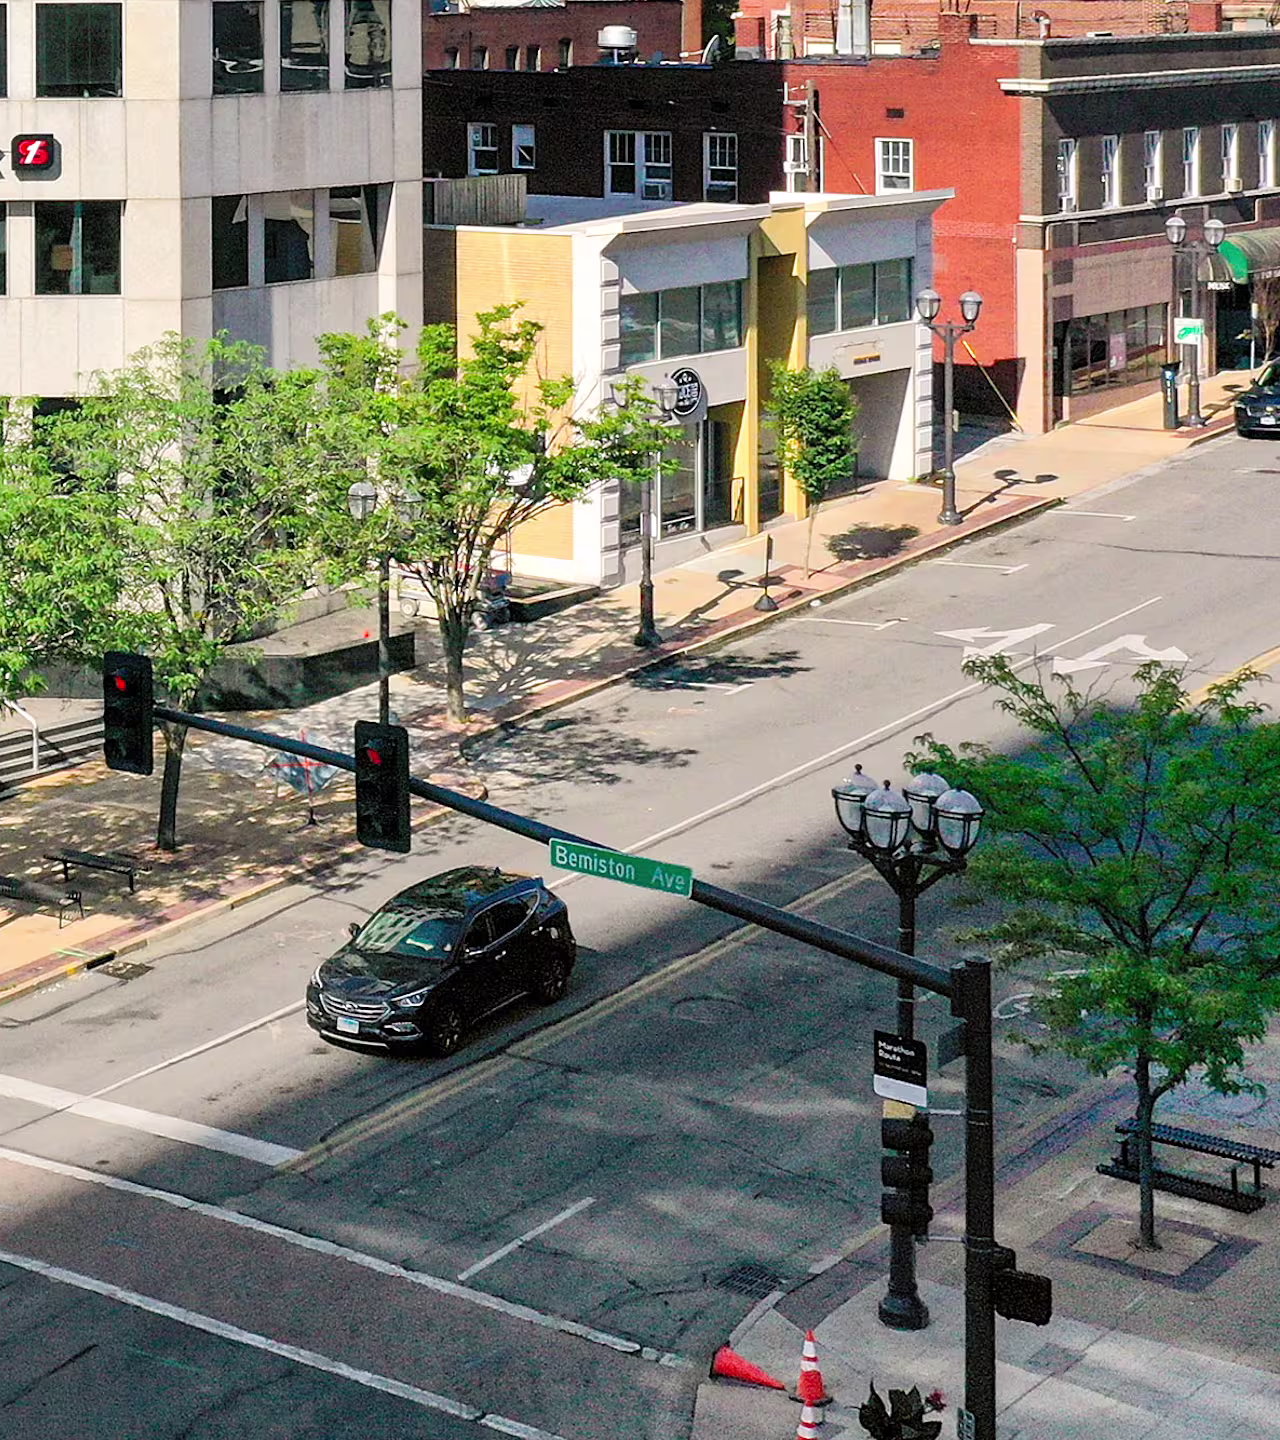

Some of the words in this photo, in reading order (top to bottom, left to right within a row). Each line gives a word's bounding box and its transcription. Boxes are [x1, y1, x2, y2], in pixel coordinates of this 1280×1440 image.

[555, 845, 635, 880] Bemiston
[651, 866, 685, 891] Ave
[878, 1040, 915, 1057] Marathon
[878, 1049, 901, 1062] Route
